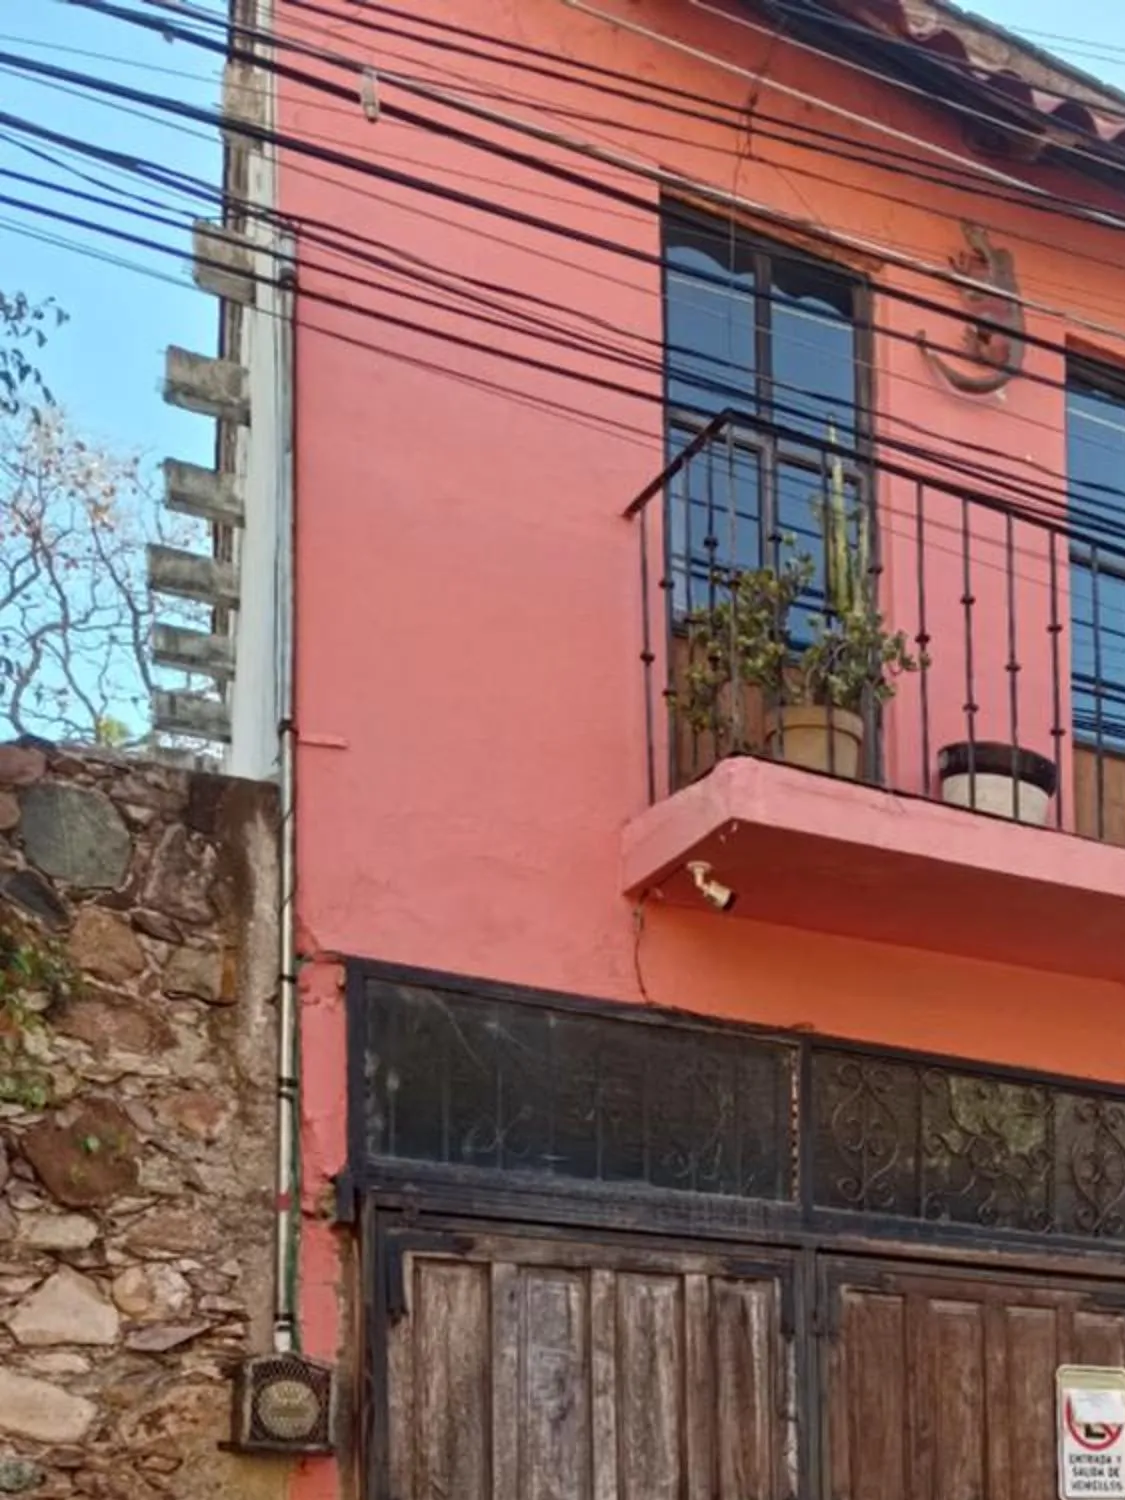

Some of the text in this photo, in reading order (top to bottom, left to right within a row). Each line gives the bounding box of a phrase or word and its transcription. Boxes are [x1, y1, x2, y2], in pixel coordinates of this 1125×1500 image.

[1069, 1454, 1112, 1465] ENTRADA
[1072, 1466, 1120, 1478] SALIDA DE
